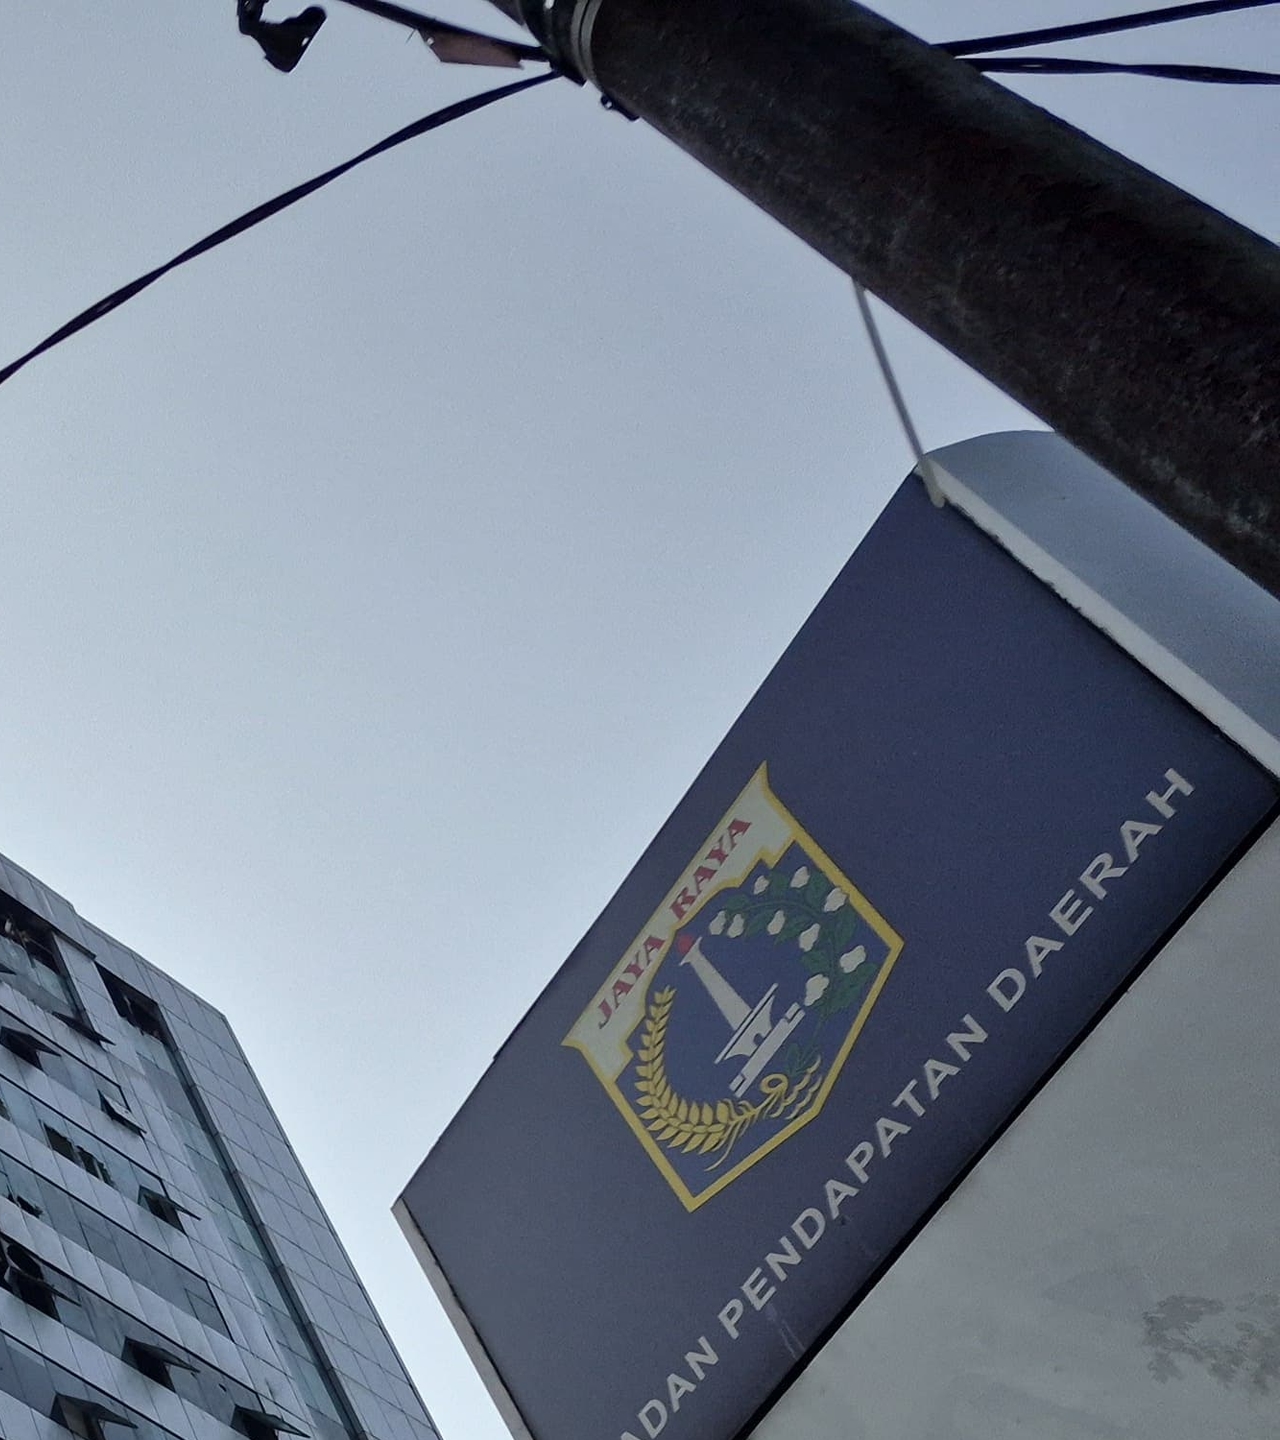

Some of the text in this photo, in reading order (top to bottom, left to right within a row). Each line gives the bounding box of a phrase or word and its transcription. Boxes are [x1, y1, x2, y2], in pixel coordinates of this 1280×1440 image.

[597, 818, 752, 1029] JAYA RAYA
[718, 1014, 988, 1339] PENDAPATAN
[987, 768, 1194, 1012] DAERAH
